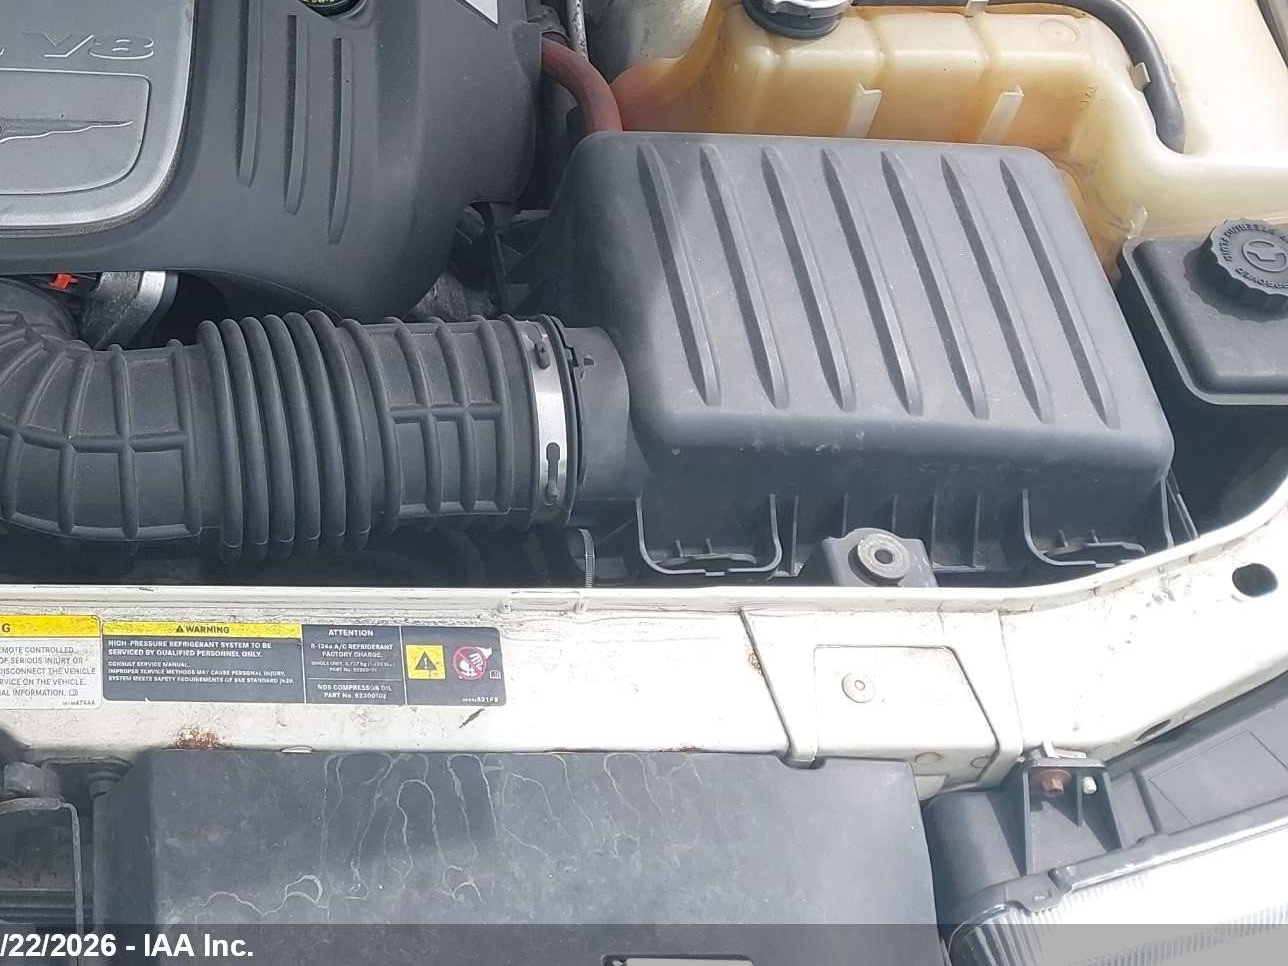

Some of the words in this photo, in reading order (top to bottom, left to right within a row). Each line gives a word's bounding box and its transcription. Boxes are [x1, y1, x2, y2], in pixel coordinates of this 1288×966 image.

[41, 33, 155, 60] V8
[185, 626, 230, 634] WARNING
[328, 629, 374, 637] ATTENTION
[108, 640, 167, 648] HIGH-PRESSURE
[24, 646, 74, 654] CONTROLLED
[241, 650, 263, 658] ONLY.
[10, 657, 42, 665] SERIOUS
[44, 657, 69, 665] INJURY
[72, 657, 83, 665] OR
[48, 667, 61, 675] THE
[64, 667, 96, 675] VEHICLE
[22, 678, 34, 686] ON
[36, 678, 50, 686] THE
